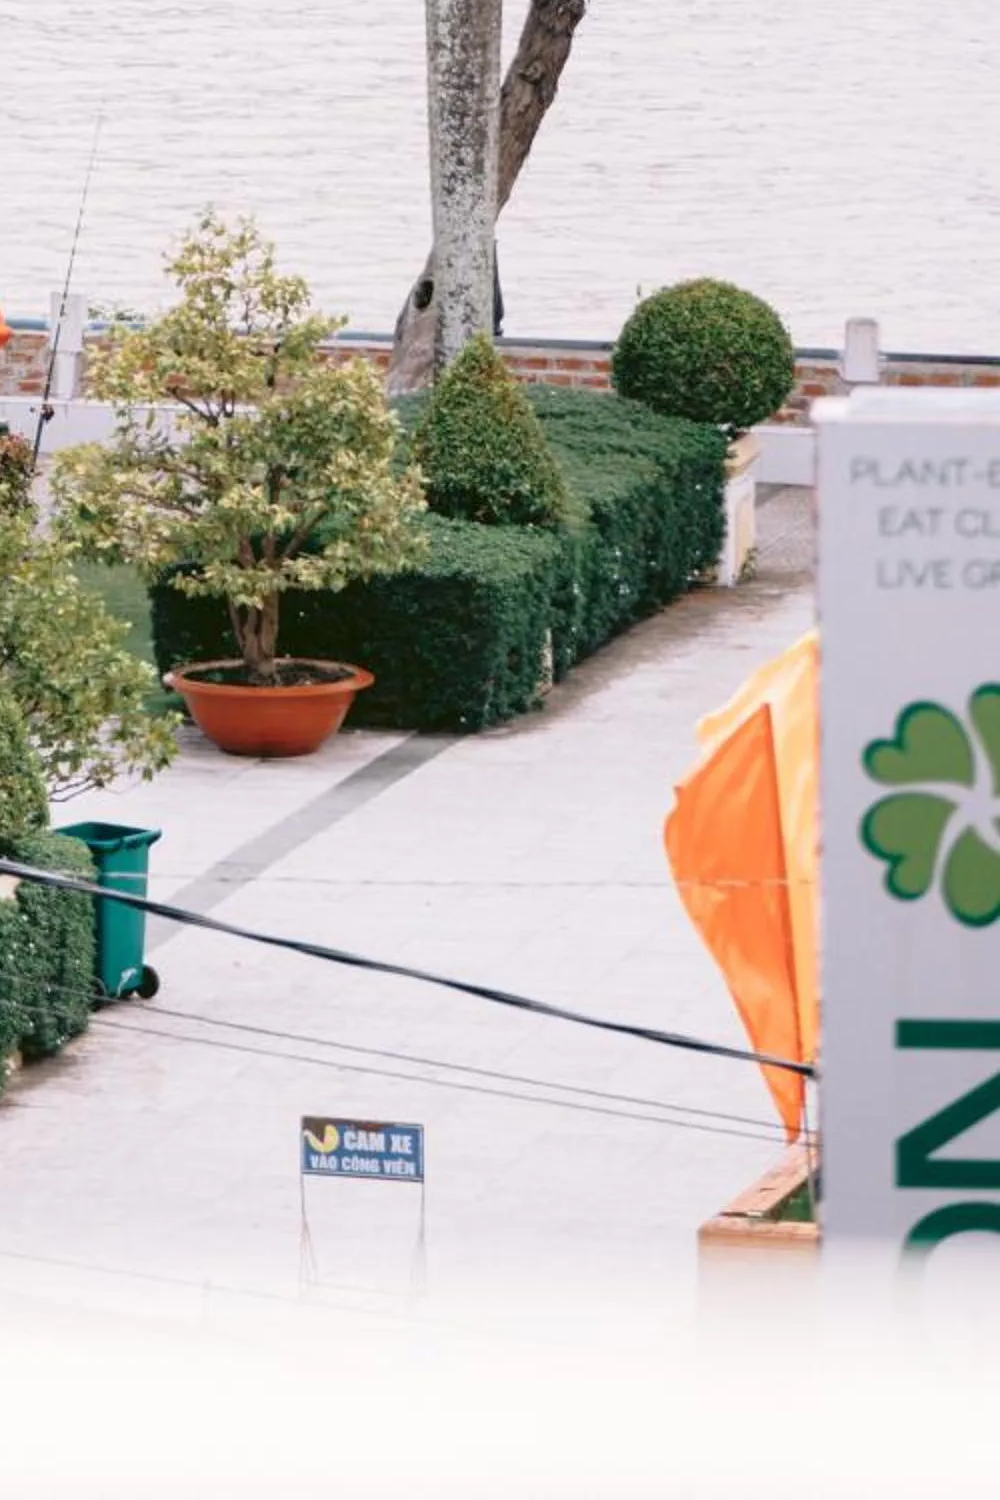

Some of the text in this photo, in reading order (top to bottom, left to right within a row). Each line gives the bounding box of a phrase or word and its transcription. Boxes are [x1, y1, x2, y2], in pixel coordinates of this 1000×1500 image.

[878, 507, 943, 537] EAT
[876, 559, 951, 589] LIVE
[390, 1134, 413, 1154] XE
